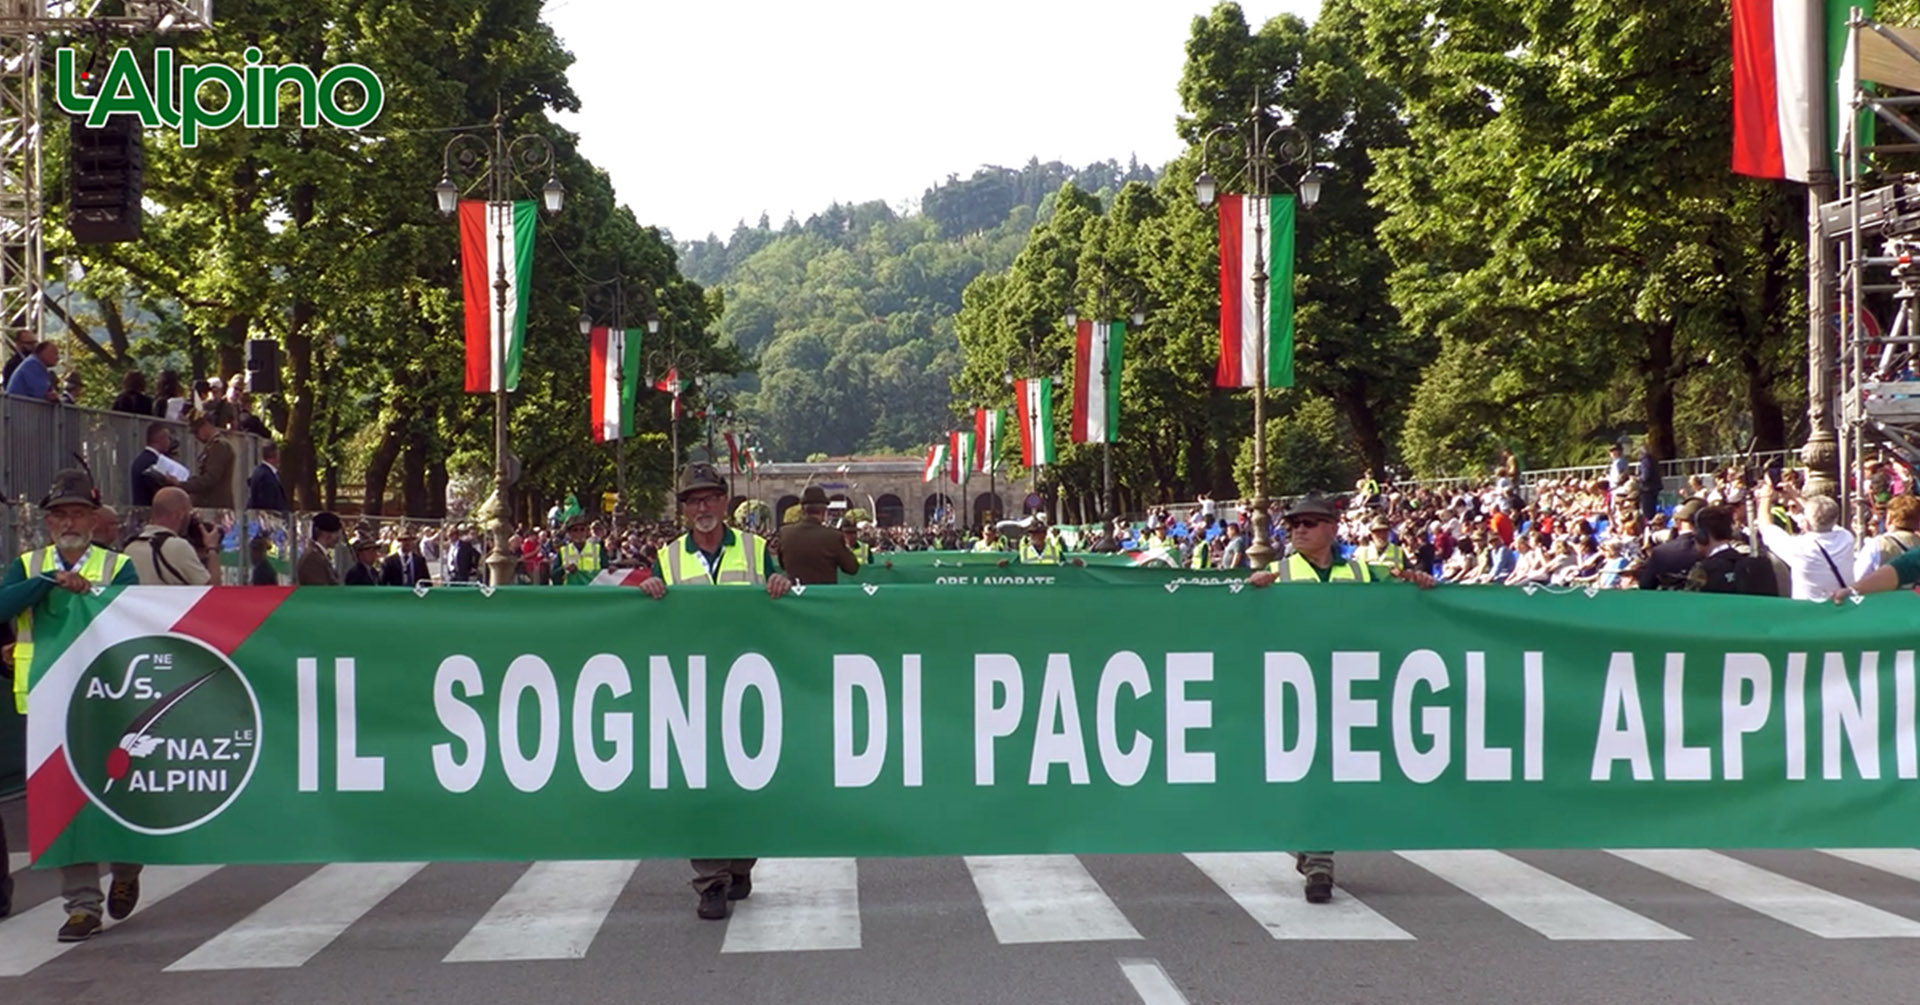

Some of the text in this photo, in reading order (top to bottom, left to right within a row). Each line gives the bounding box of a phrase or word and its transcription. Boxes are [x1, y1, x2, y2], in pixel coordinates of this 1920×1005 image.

[297, 649, 1918, 793] IL SOGNO DI PACE DEGLI ALPINI
[128, 770, 227, 792] ALPINI
